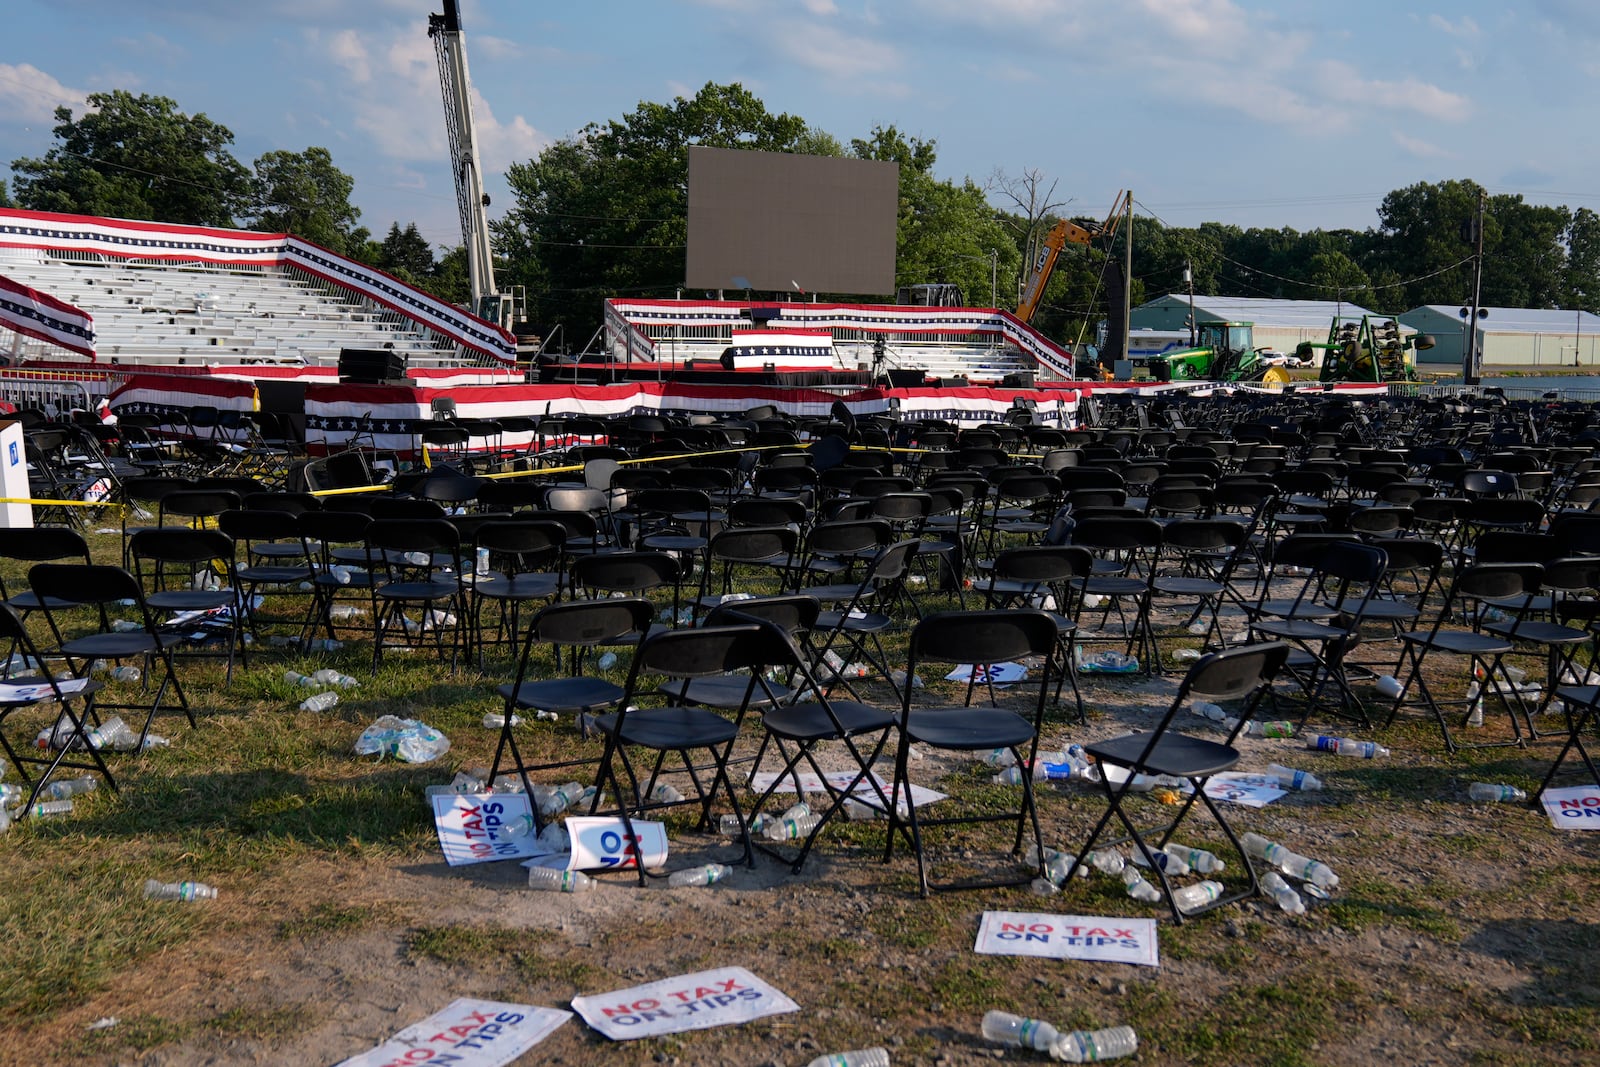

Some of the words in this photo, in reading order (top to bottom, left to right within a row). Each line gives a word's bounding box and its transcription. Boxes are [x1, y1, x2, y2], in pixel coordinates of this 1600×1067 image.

[1036, 246, 1051, 273] JCB
[1559, 796, 1600, 809] NO
[1561, 806, 1600, 819] ON
[459, 805, 486, 839] TAX
[483, 802, 504, 840] TIPS
[469, 843, 496, 858] NO
[492, 842, 520, 855] ON
[995, 932, 1049, 943] ON
[1062, 936, 1140, 949] TIPS
[1001, 923, 1055, 934] NO
[1065, 926, 1135, 938] TAX
[600, 998, 661, 1018] NO
[667, 978, 746, 1001] TAX
[611, 1007, 674, 1026] ON
[677, 987, 763, 1012] TIPS
[428, 1009, 497, 1043] TAX
[452, 1011, 525, 1049] TIPS
